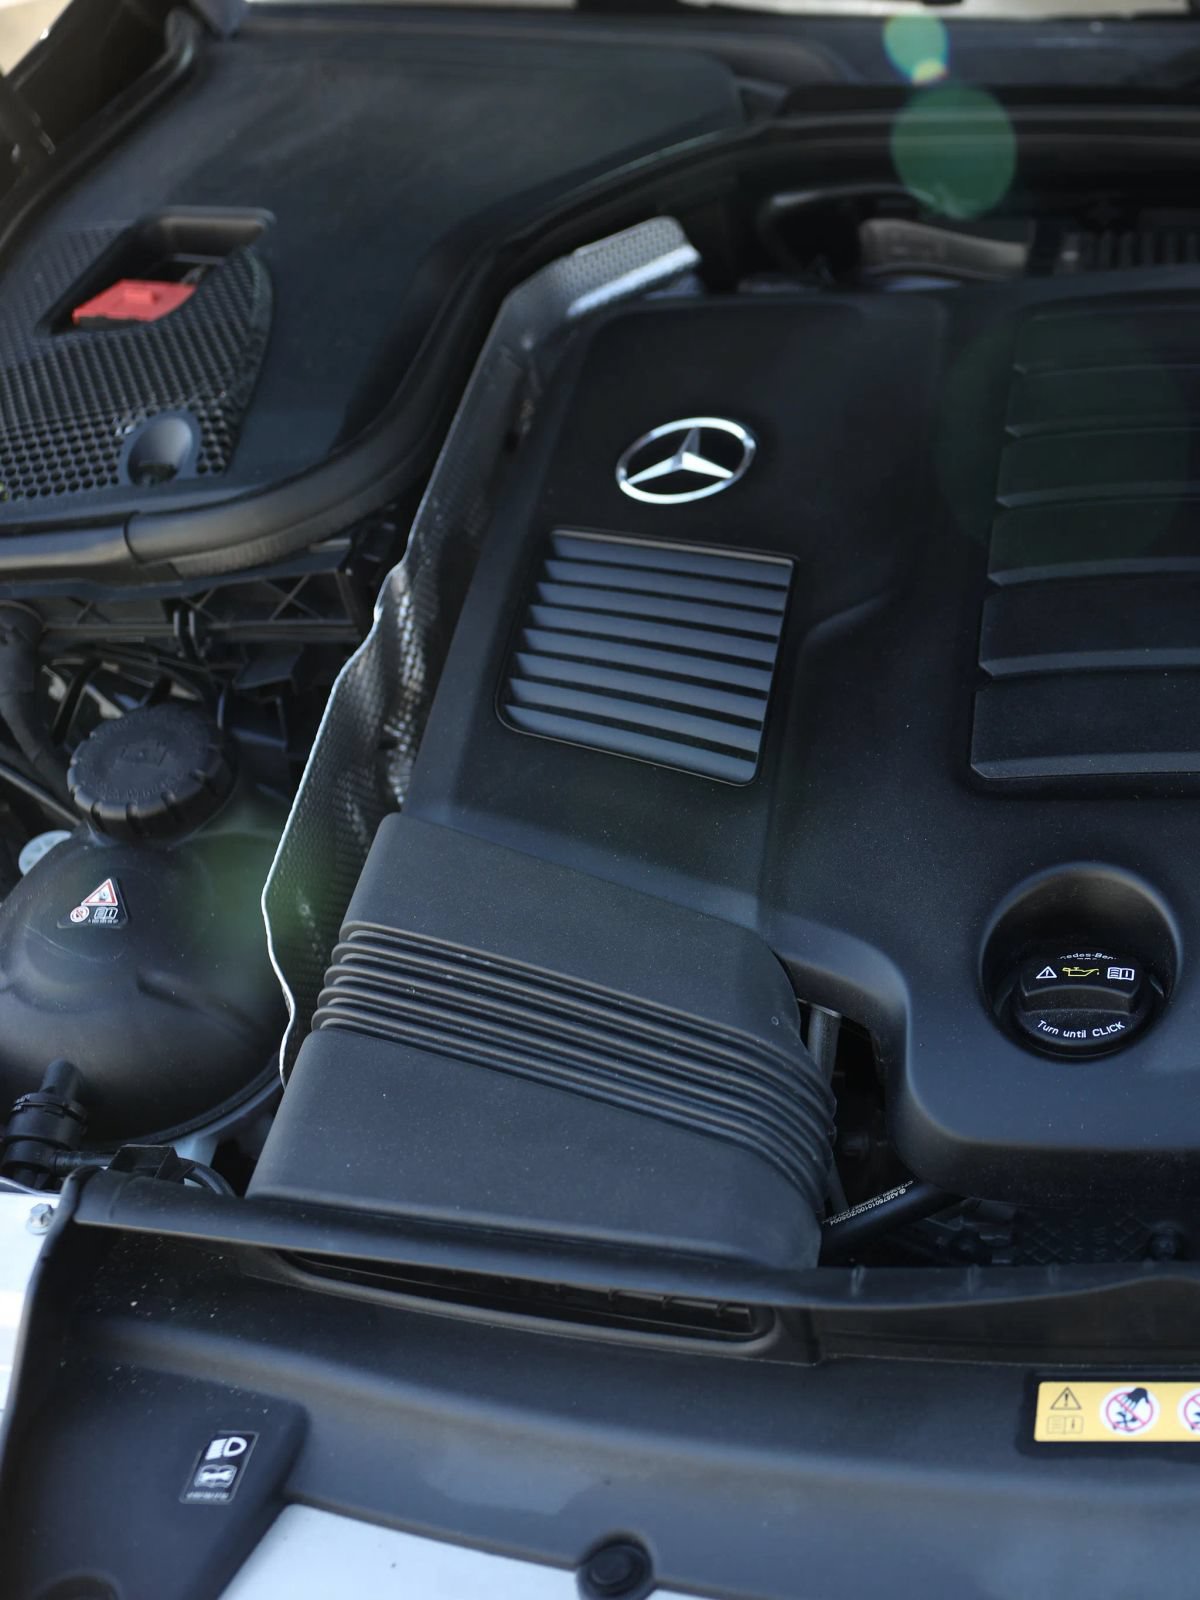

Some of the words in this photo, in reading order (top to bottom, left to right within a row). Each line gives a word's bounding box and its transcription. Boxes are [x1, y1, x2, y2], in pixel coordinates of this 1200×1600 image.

[1037, 1019, 1059, 1035] Turn
[1063, 1029, 1087, 1038] until
[1092, 1021, 1125, 1037] CLICK
